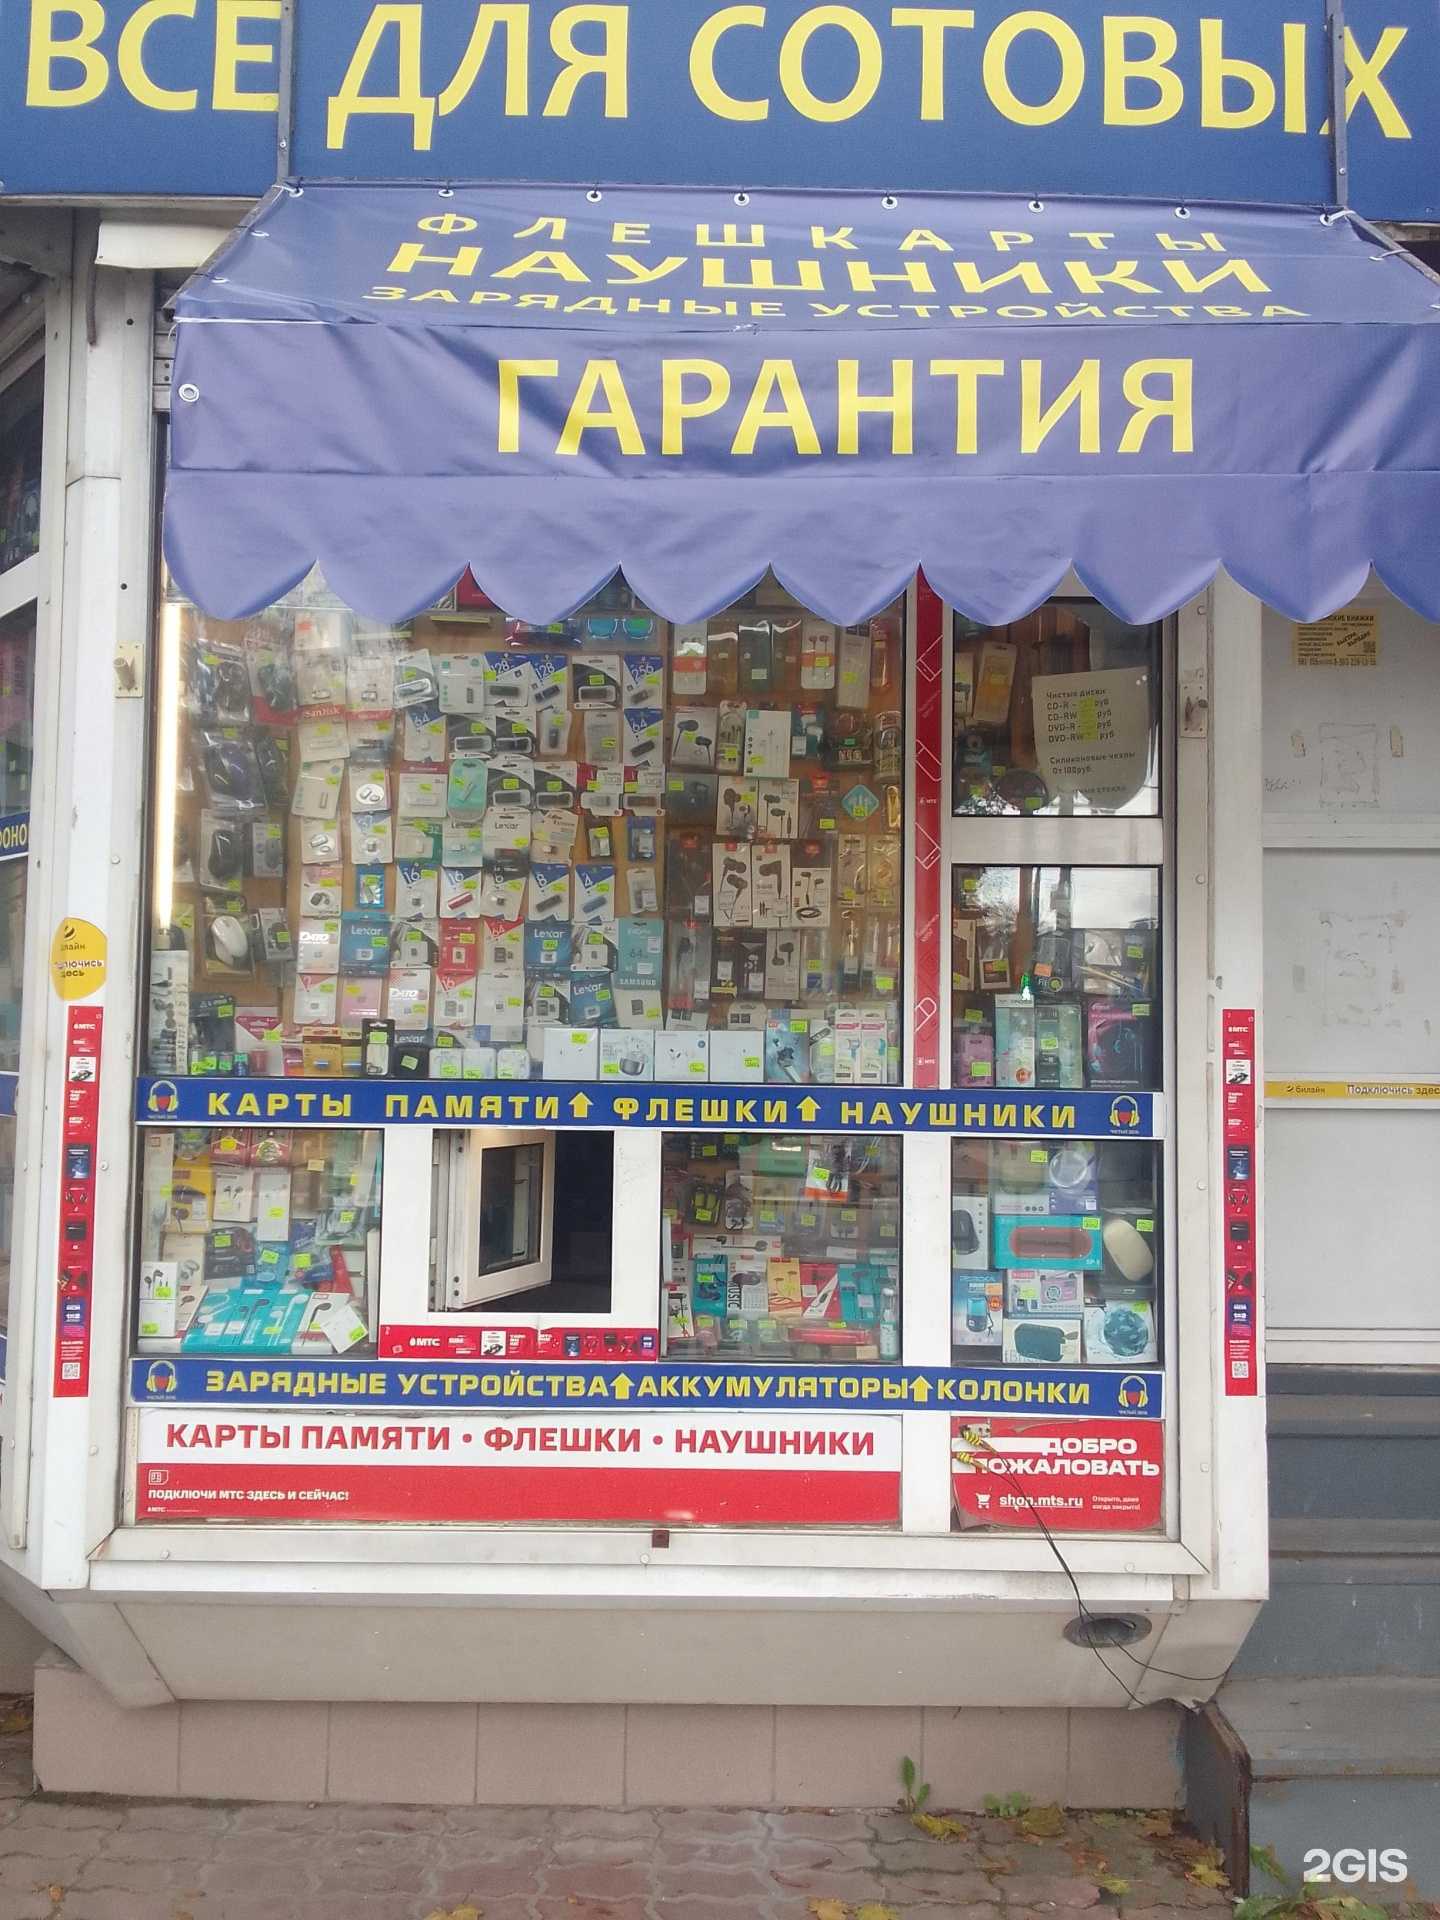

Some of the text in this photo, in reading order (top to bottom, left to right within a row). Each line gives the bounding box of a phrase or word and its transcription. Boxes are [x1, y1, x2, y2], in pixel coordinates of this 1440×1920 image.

[25, 0, 1412, 150] ВСЕ ДЛЯ СОТОВЫХ
[386, 242, 1272, 295] НАУШНИКИ
[362, 286, 1311, 319] ЗАРЯДНЫЕ УСТРОЙСТВА
[497, 358, 1193, 456] ГАРАНТИЯ
[351, 925, 383, 936] Lexar
[534, 928, 566, 938] Lexar
[573, 983, 602, 997] Lexar
[619, 978, 657, 987] SAMSUNG
[394, 1032, 425, 1044] Lexar
[1347, 1084, 1413, 1096] Подключись
[207, 1092, 1076, 1128] КАРТЫ ПАМЯТИ ФЛЕШКИ НАУШНИКИ
[416, 1337, 441, 1347] МТС
[205, 1370, 1091, 1404] ЗАРЯДНЫЕ УСТРОЙСТВА АККУМУЛЯТОРЫ КОЛОНКИ
[166, 1423, 875, 1457] КАРТЫ ПАМЯТИ ФЛЕШКИ НАУШНИКИ
[1041, 1437, 1138, 1457] ДОБРО
[148, 1488, 350, 1502] ПОДКЛЮЧИ МТС ЗДЕСЬ И СЕЙЧАС!
[999, 1494, 1084, 1509] shop.mts.ru
